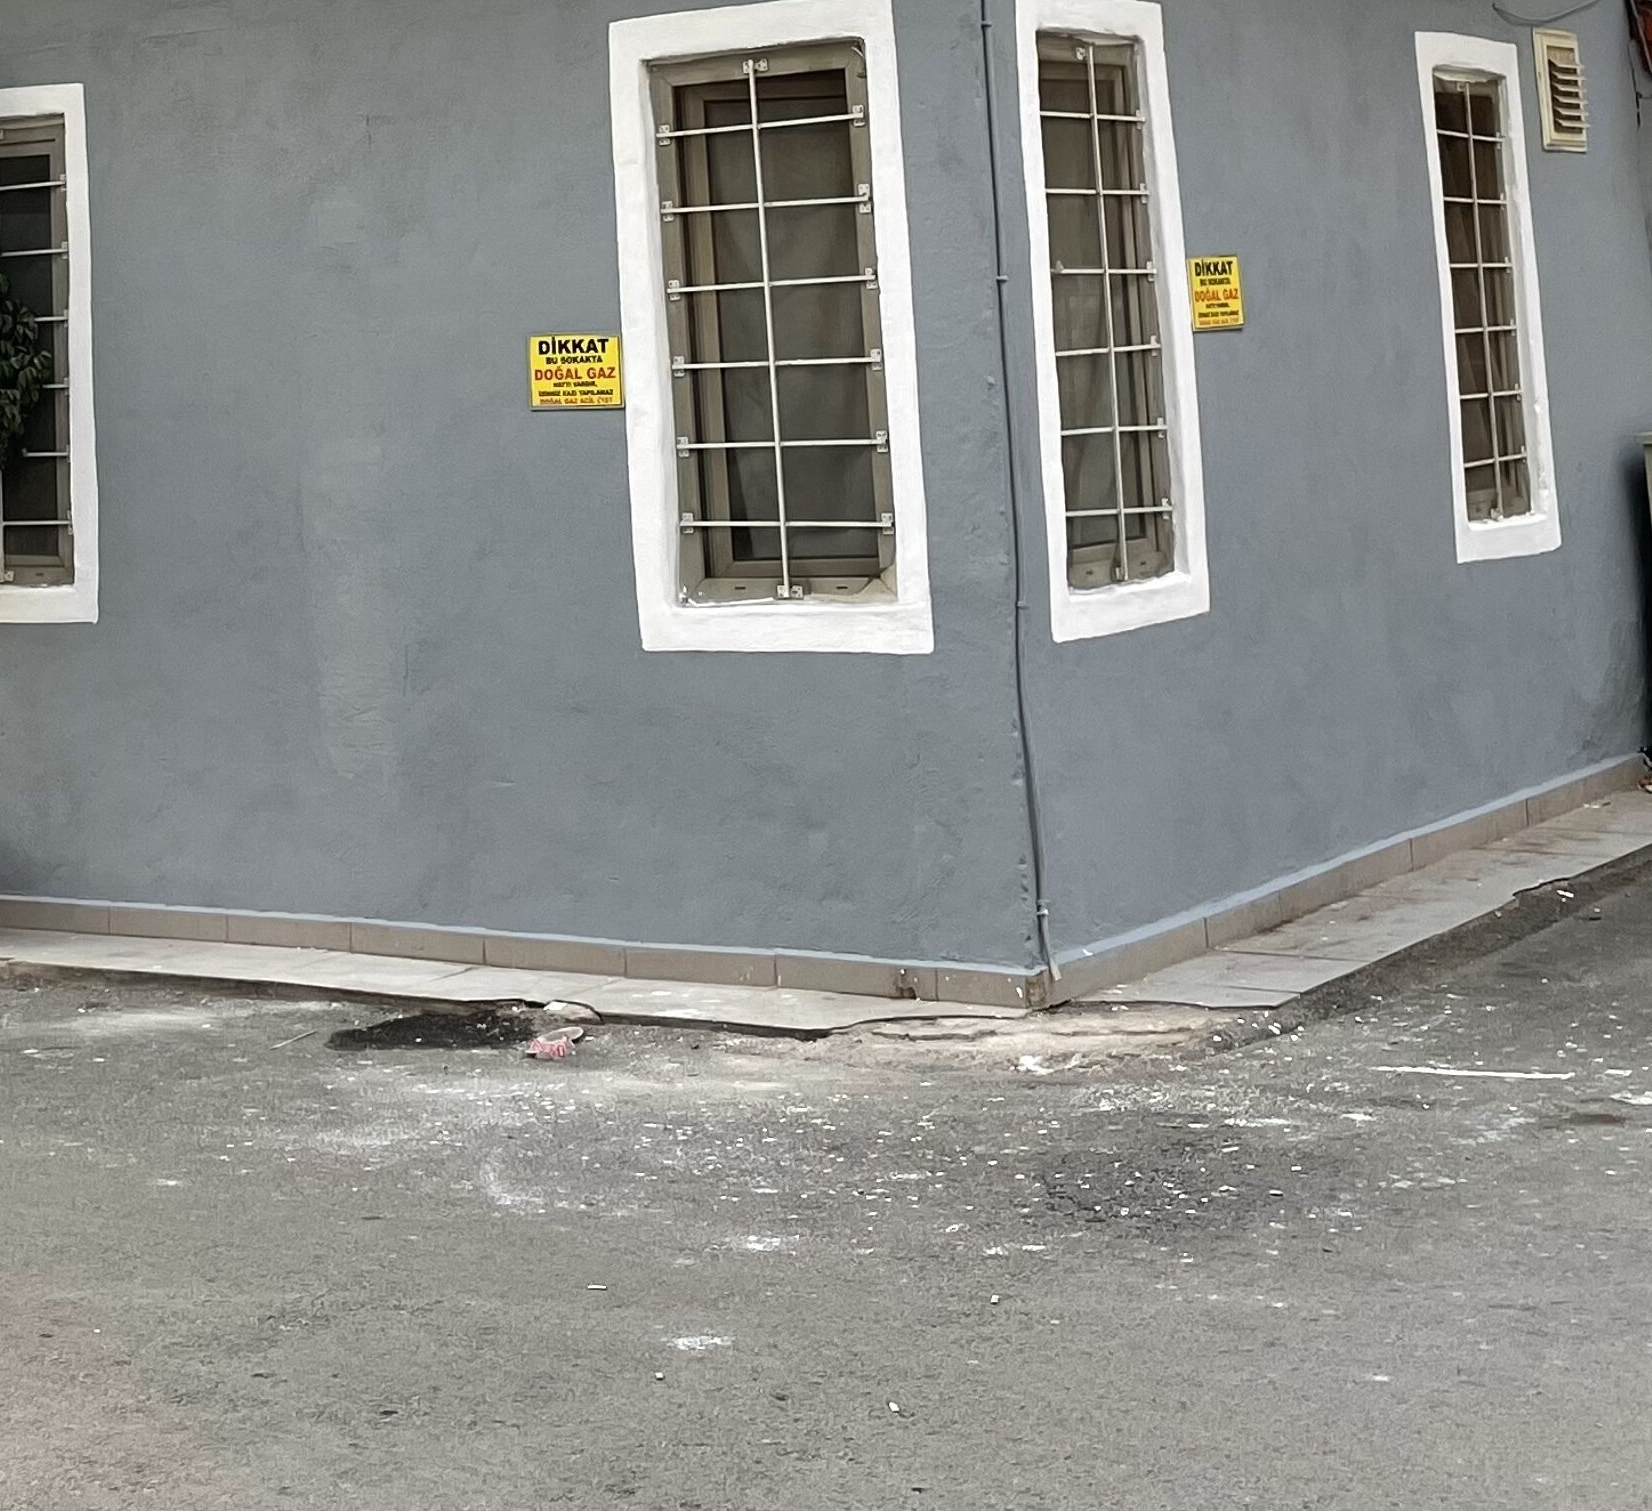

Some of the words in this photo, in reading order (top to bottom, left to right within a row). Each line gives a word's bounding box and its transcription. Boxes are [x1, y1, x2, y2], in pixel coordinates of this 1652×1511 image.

[1194, 259, 1233, 276] DİKKAT
[538, 336, 610, 355] DİKKAT
[534, 365, 583, 381] DOĞAL
[587, 366, 617, 379] GAZ
